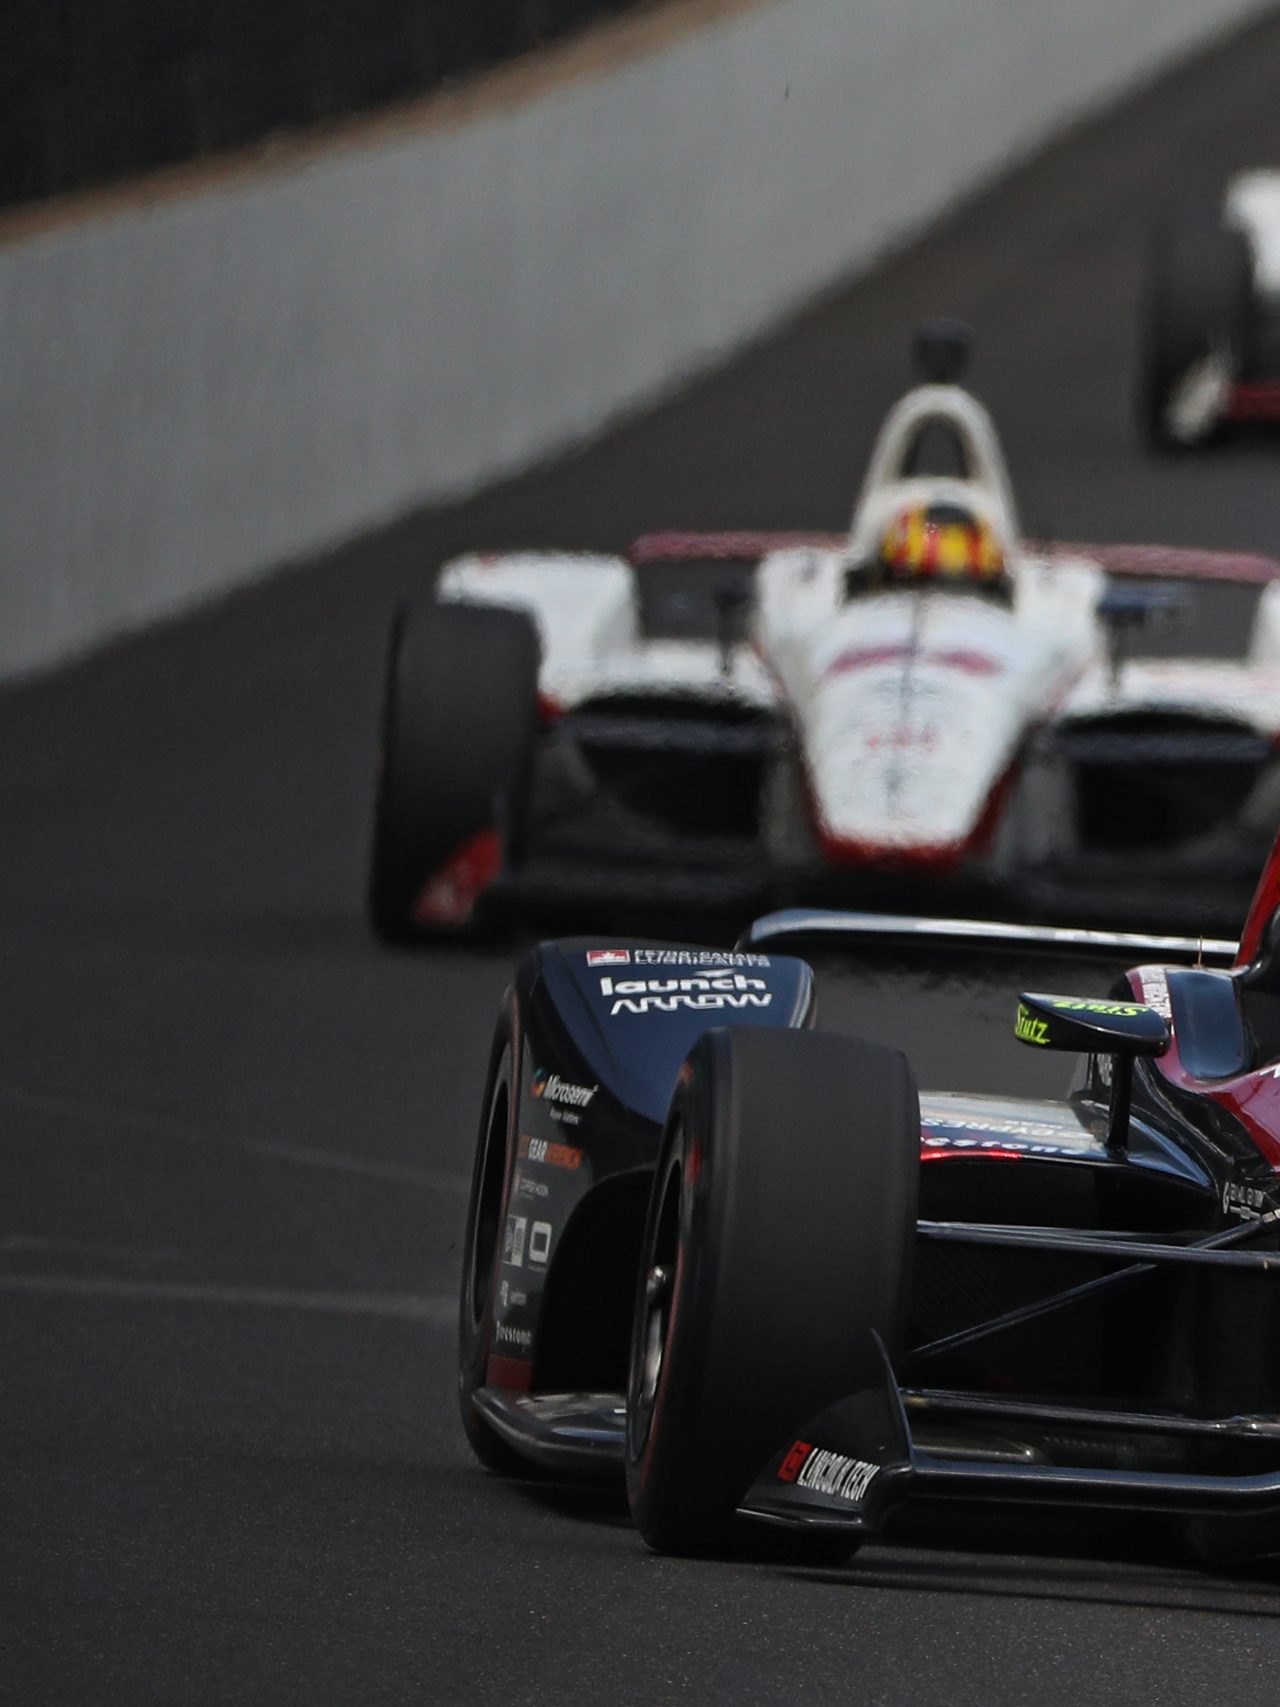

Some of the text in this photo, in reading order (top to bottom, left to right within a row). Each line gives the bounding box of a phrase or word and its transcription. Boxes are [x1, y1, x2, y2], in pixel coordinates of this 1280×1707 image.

[600, 973, 767, 996] launch
[609, 993, 773, 1016] ARROW
[920, 1136, 1087, 1156] estone
